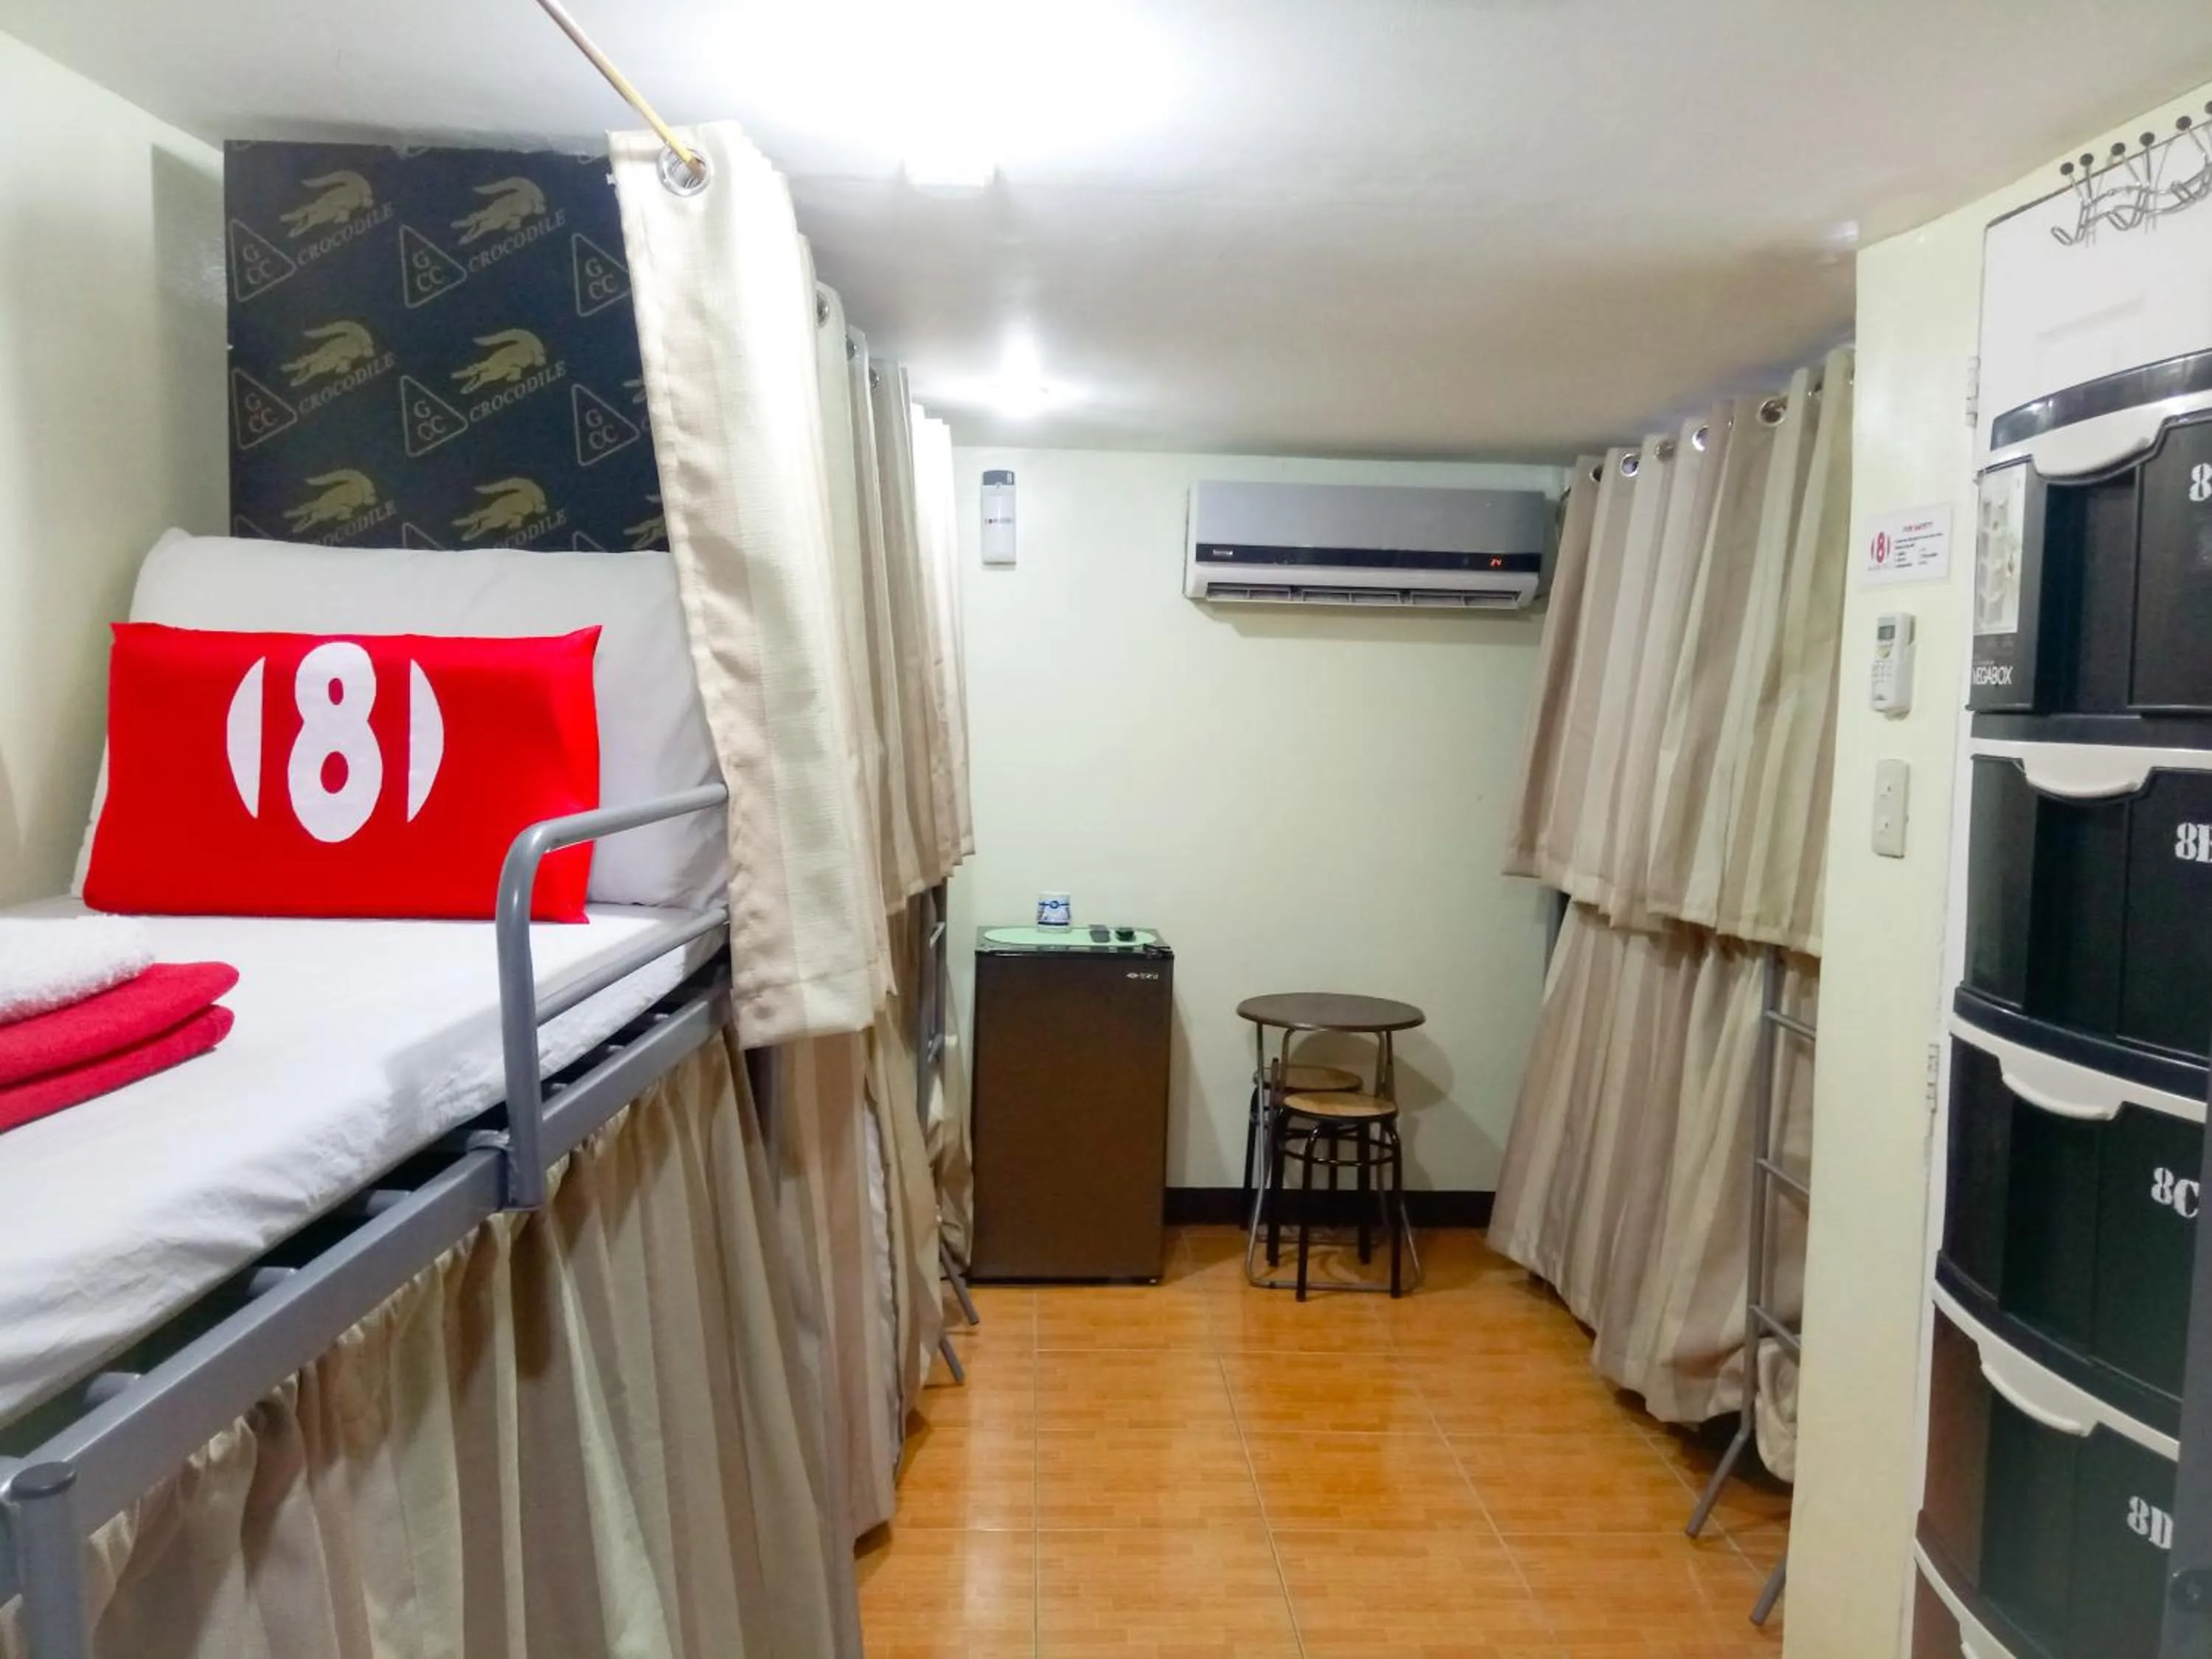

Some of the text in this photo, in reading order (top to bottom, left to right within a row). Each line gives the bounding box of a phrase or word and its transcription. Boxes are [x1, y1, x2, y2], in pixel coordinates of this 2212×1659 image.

[296, 201, 394, 265] CROCODILE
[467, 208, 566, 272] CROCODILE
[243, 243, 260, 262] G
[412, 248, 430, 268] G
[417, 265, 443, 291] CC
[585, 258, 602, 277] G
[589, 274, 618, 300] CC
[299, 350, 396, 413] CROCODILE
[470, 360, 567, 422] CROCODILE
[245, 392, 262, 411] G
[414, 400, 431, 418] G
[417, 415, 446, 441] CC
[585, 408, 602, 427] G
[589, 425, 618, 450] CC
[310, 499, 397, 546] OCODILE
[493, 507, 567, 550] CODILE
[2151, 1167, 2199, 1218] 8C
[2126, 1495, 2173, 1549] 8D
